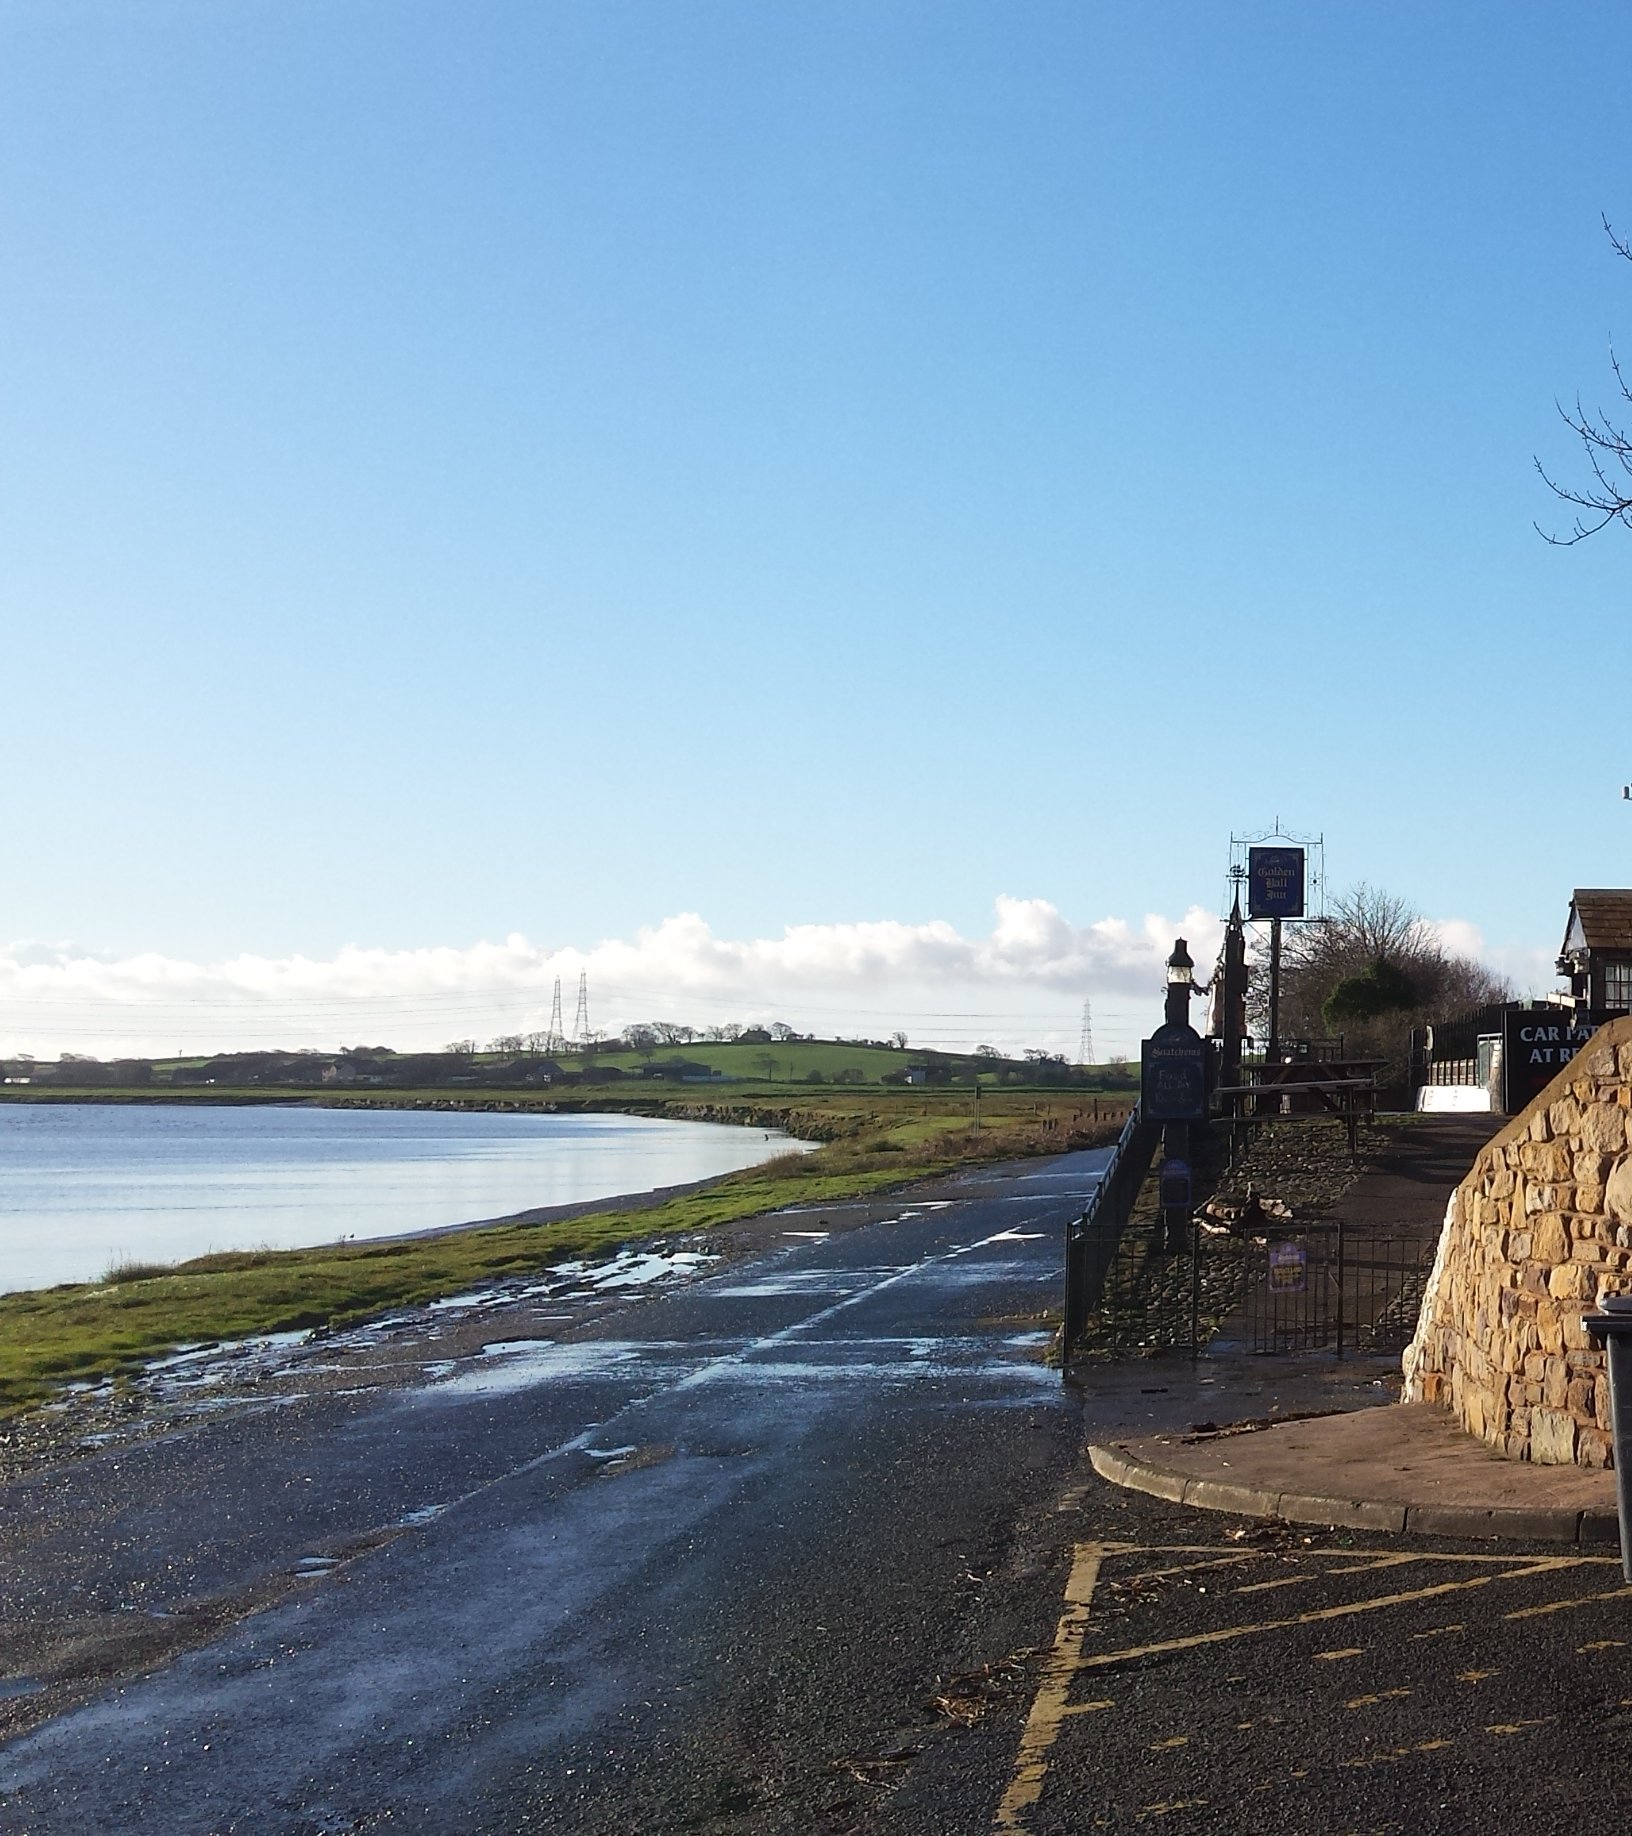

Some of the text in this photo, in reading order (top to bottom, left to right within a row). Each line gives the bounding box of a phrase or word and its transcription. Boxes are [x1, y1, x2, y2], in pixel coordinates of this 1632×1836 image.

[1257, 866, 1295, 878] Golden
[1266, 877, 1287, 888] Ball
[1265, 889, 1287, 901] Inn
[1520, 1025, 1600, 1042] CAR PA
[1529, 1047, 1580, 1063] AT RE
